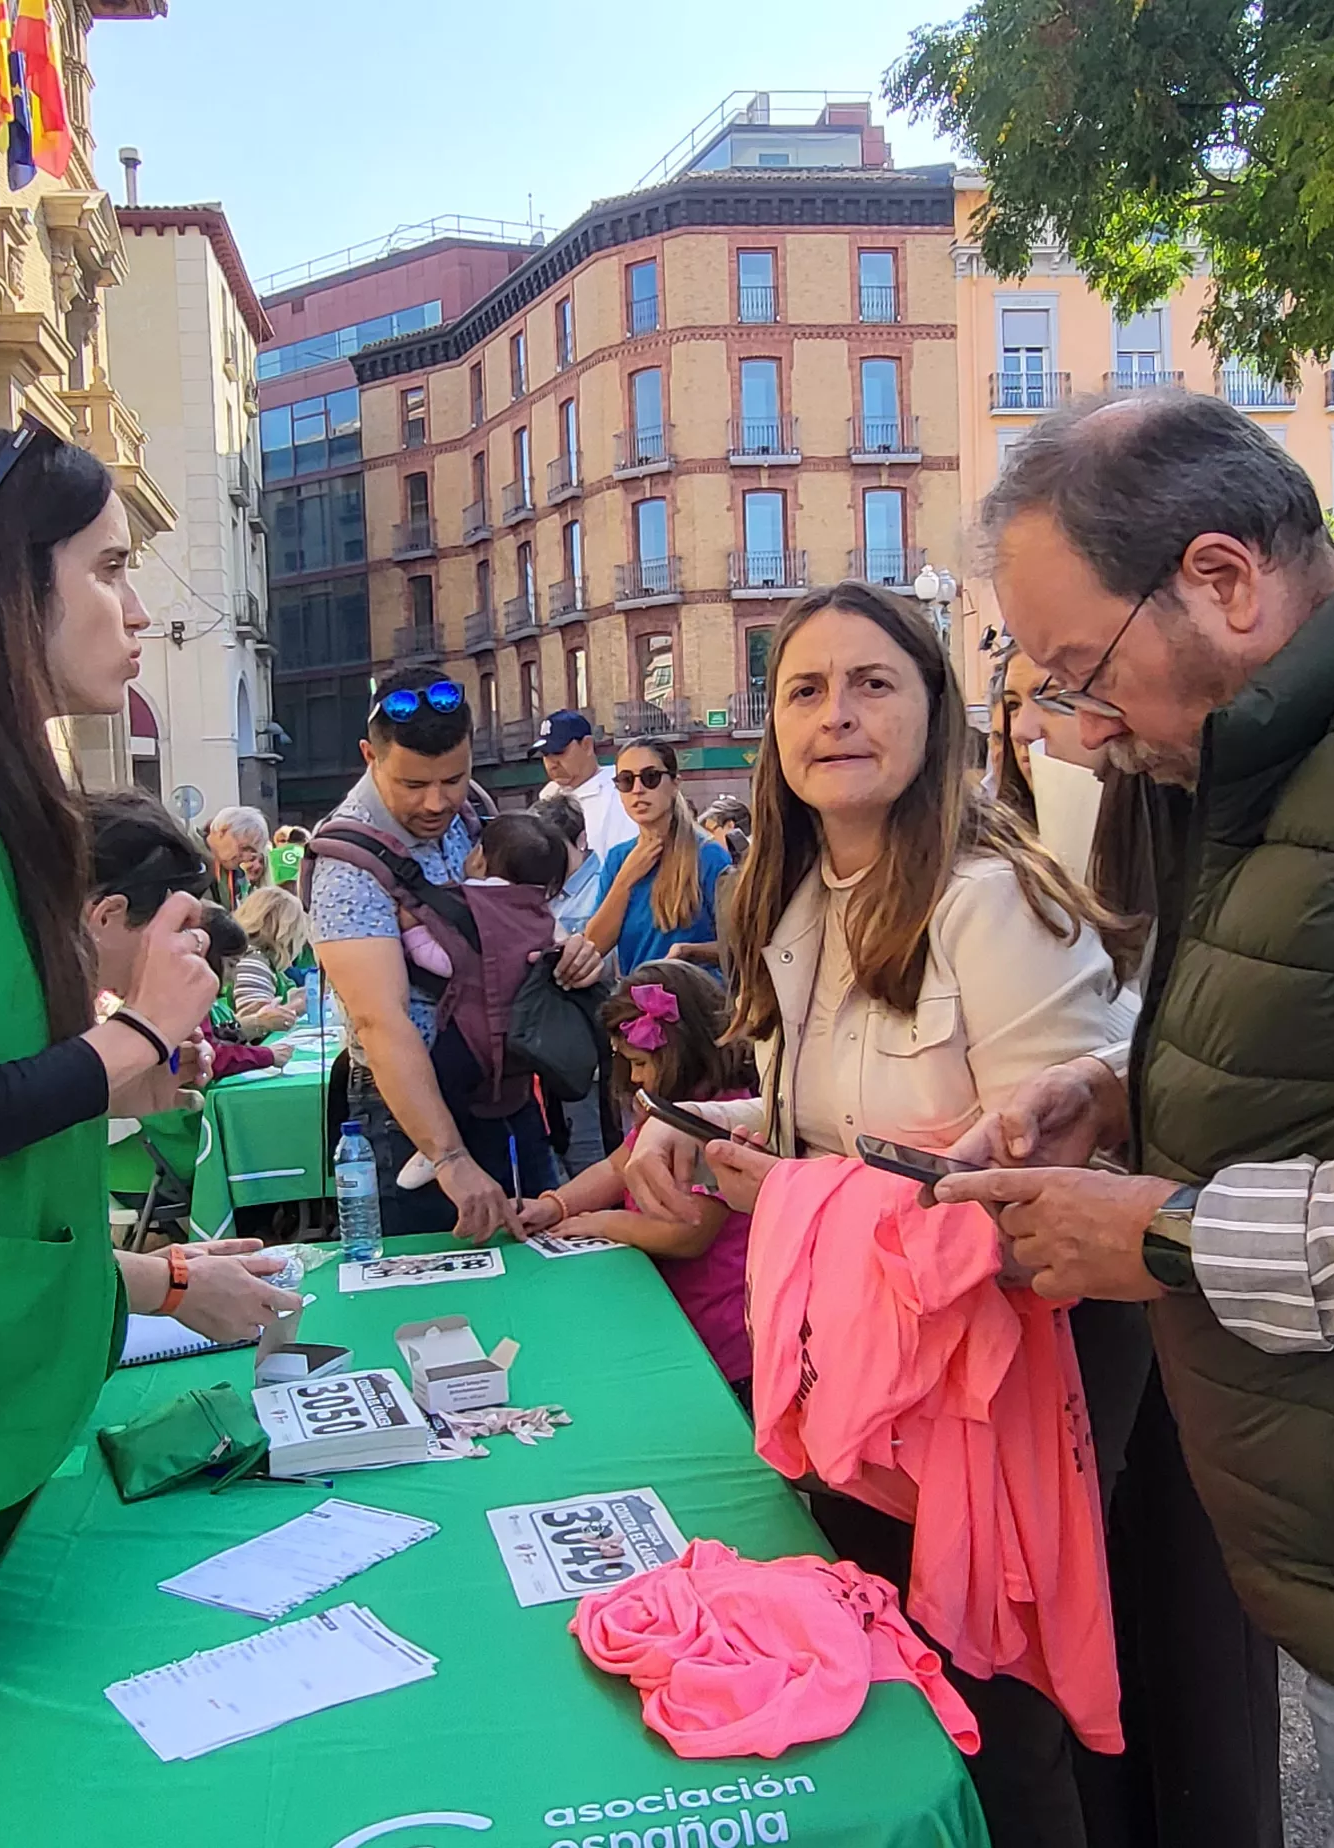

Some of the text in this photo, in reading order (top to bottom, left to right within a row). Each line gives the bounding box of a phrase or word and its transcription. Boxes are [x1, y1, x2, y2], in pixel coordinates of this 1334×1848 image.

[297, 1382, 367, 1434] 3050
[541, 1506, 635, 1584] 3049
[635, 1542, 663, 1572] CÁNCE
[543, 1774, 816, 1828] asociación
[550, 1808, 790, 1848] añola
